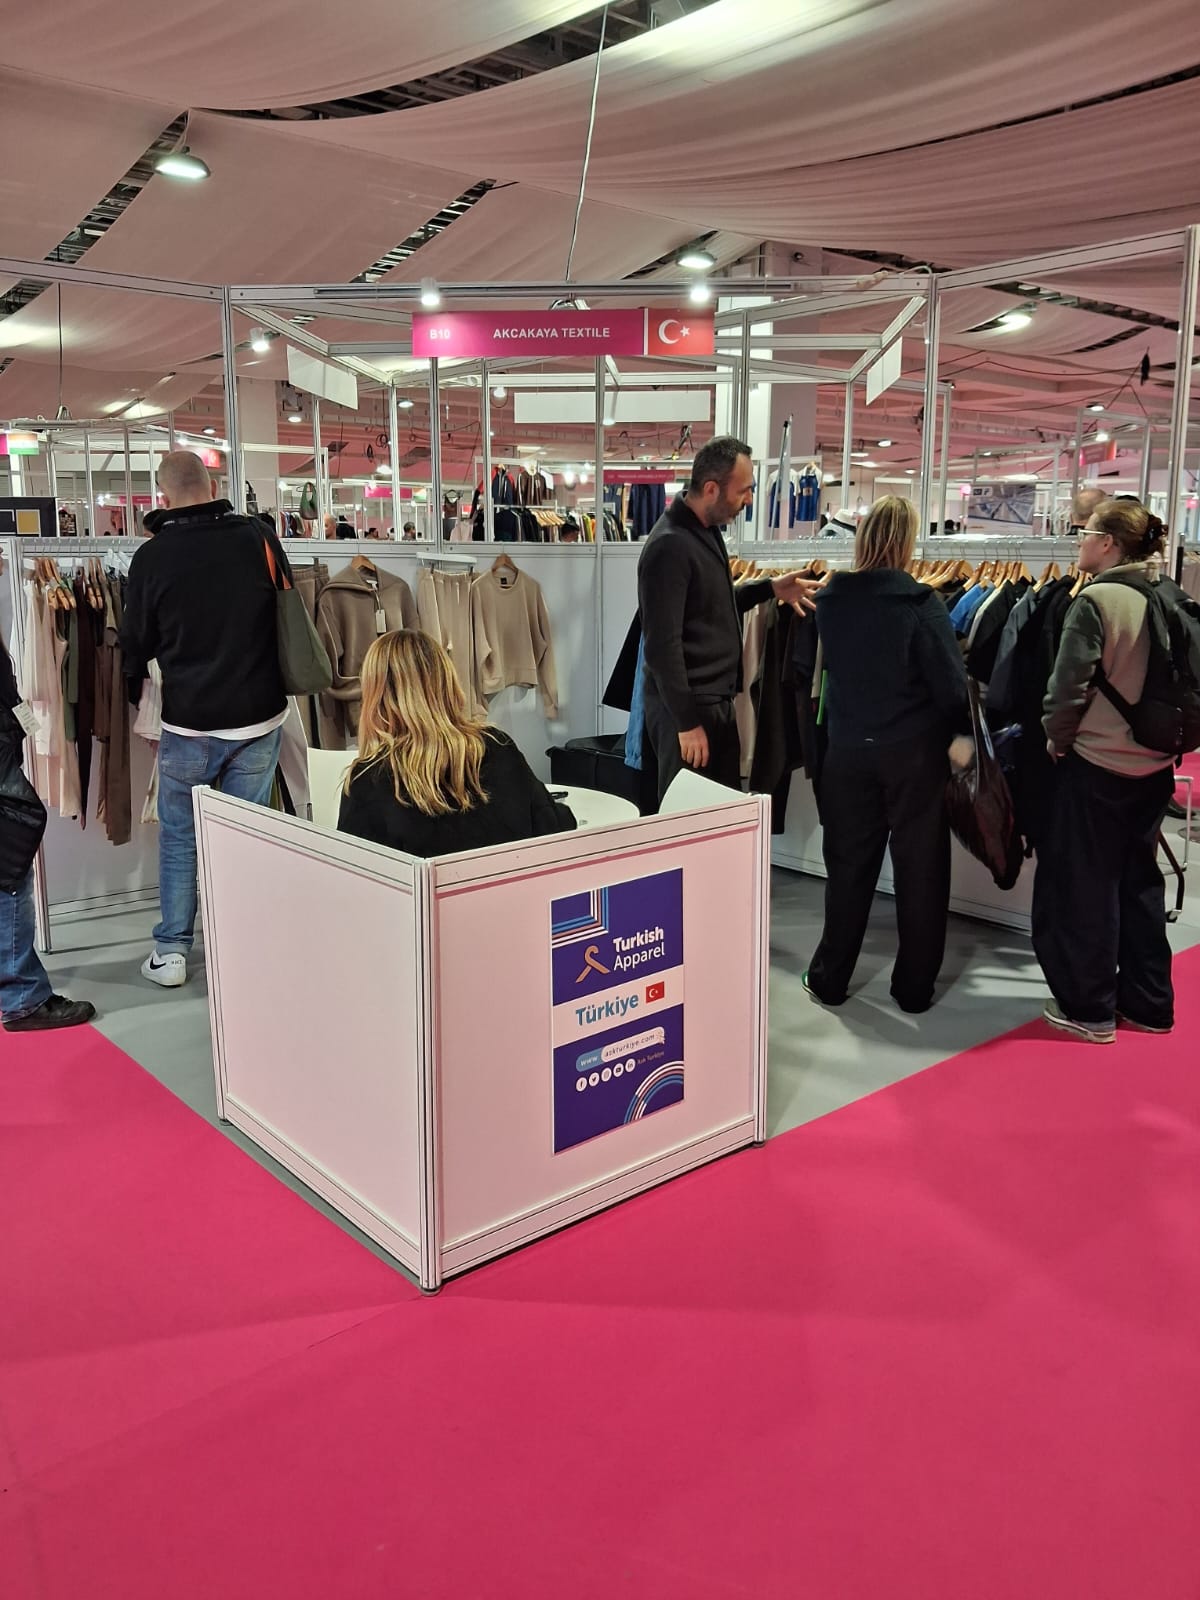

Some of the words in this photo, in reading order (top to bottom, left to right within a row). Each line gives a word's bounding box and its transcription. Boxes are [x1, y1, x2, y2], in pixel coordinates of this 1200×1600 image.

[429, 329, 450, 340] B10
[493, 328, 558, 338] AKCAKAYA
[561, 327, 611, 338] TEXTILE
[613, 926, 664, 953] Turkish
[613, 941, 665, 972] Apparel
[575, 994, 639, 1026] Türkiye
